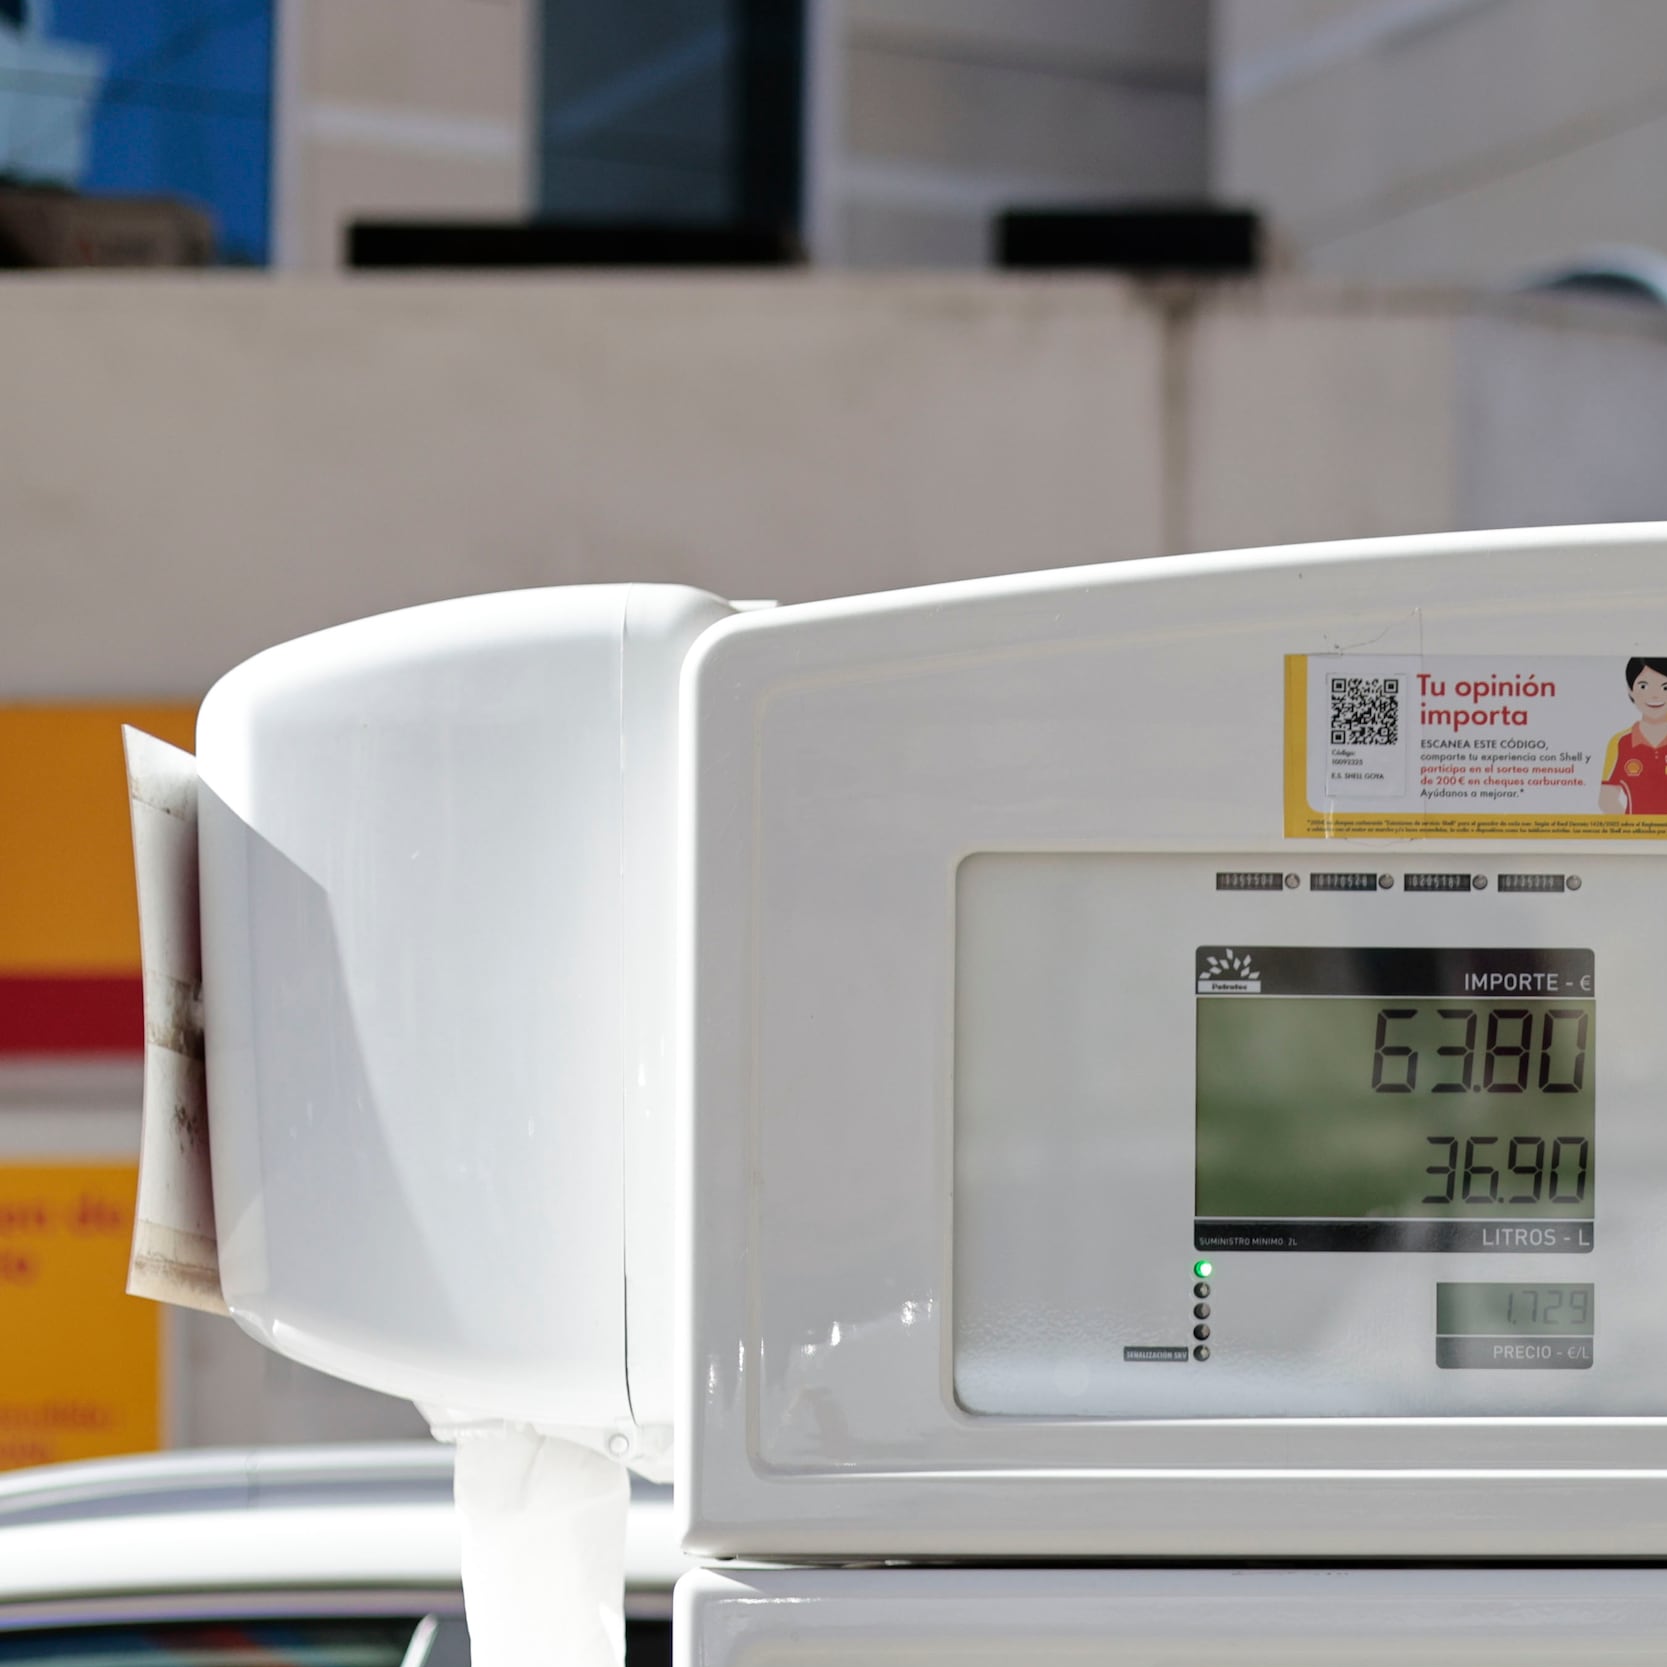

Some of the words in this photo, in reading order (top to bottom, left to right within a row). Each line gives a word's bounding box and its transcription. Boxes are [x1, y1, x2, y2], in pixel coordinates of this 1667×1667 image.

[1416, 674, 1446, 697] Tu
[1455, 673, 1556, 704] opinión
[1420, 702, 1528, 732] importa
[1420, 739, 1471, 750] ESCANEA
[1473, 739, 1497, 750] ESTE
[1500, 737, 1549, 751] CÓDIGO,
[1468, 753, 1479, 762] tu
[1480, 752, 1537, 763] experiencia
[1539, 754, 1557, 762] con
[1559, 752, 1583, 762] Shell
[1585, 755, 1592, 764] y
[1420, 764, 1466, 775] participa
[1469, 766, 1482, 774] en
[1484, 764, 1494, 774] el
[1496, 765, 1529, 774] sorteo
[1531, 764, 1575, 774] mensual
[1420, 775, 1434, 786] de
[1467, 778, 1481, 786] en
[1483, 775, 1525, 788] cheques
[1527, 775, 1587, 787] carburante.
[1419, 788, 1468, 800] Ayúdanos
[1470, 790, 1478, 798] a
[1464, 972, 1559, 992] IMPORTE
[1579, 974, 1592, 992] €
[1371, 1008, 1589, 1094] 63.80
[1421, 1135, 1589, 1204] 36.90
[1199, 1236, 1250, 1247] SUMINISTRO
[1482, 1228, 1557, 1247] LITROS
[1578, 1228, 1590, 1247] L
[1493, 1345, 1552, 1359] PRECIO
